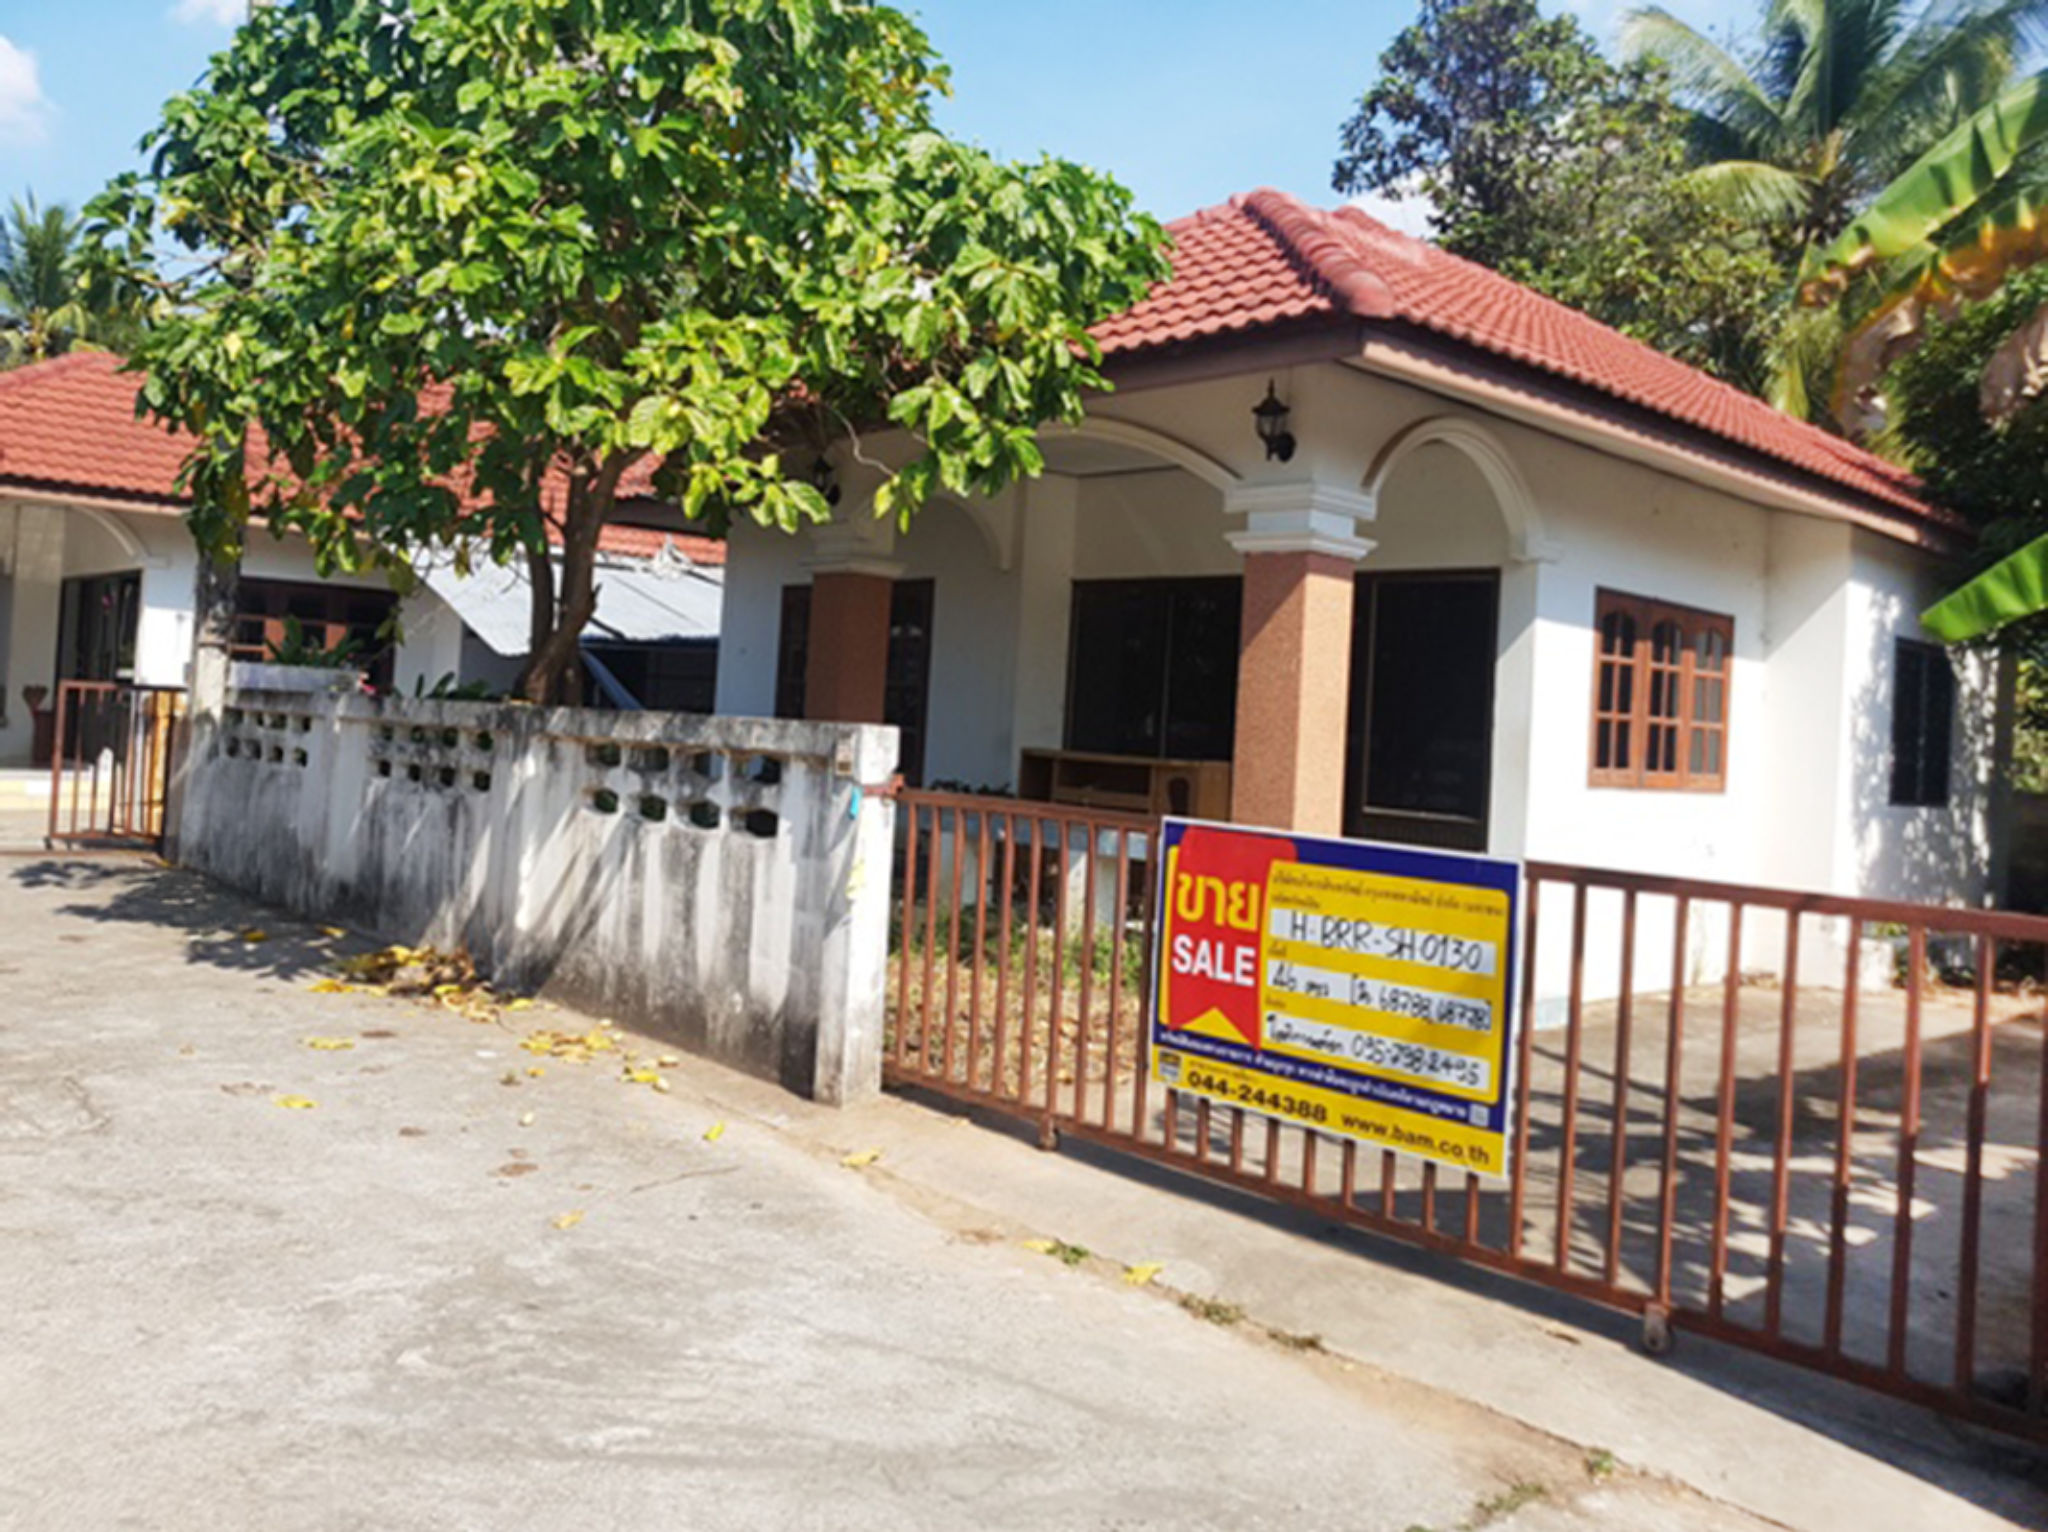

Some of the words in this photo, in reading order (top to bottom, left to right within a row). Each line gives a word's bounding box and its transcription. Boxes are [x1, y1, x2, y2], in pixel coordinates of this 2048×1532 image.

[1177, 872, 1260, 932] ขาย
[1172, 933, 1257, 987] SALE
[1187, 1070, 1328, 1123] 044-244388
[1341, 1113, 1490, 1165] www.bam.co.th
